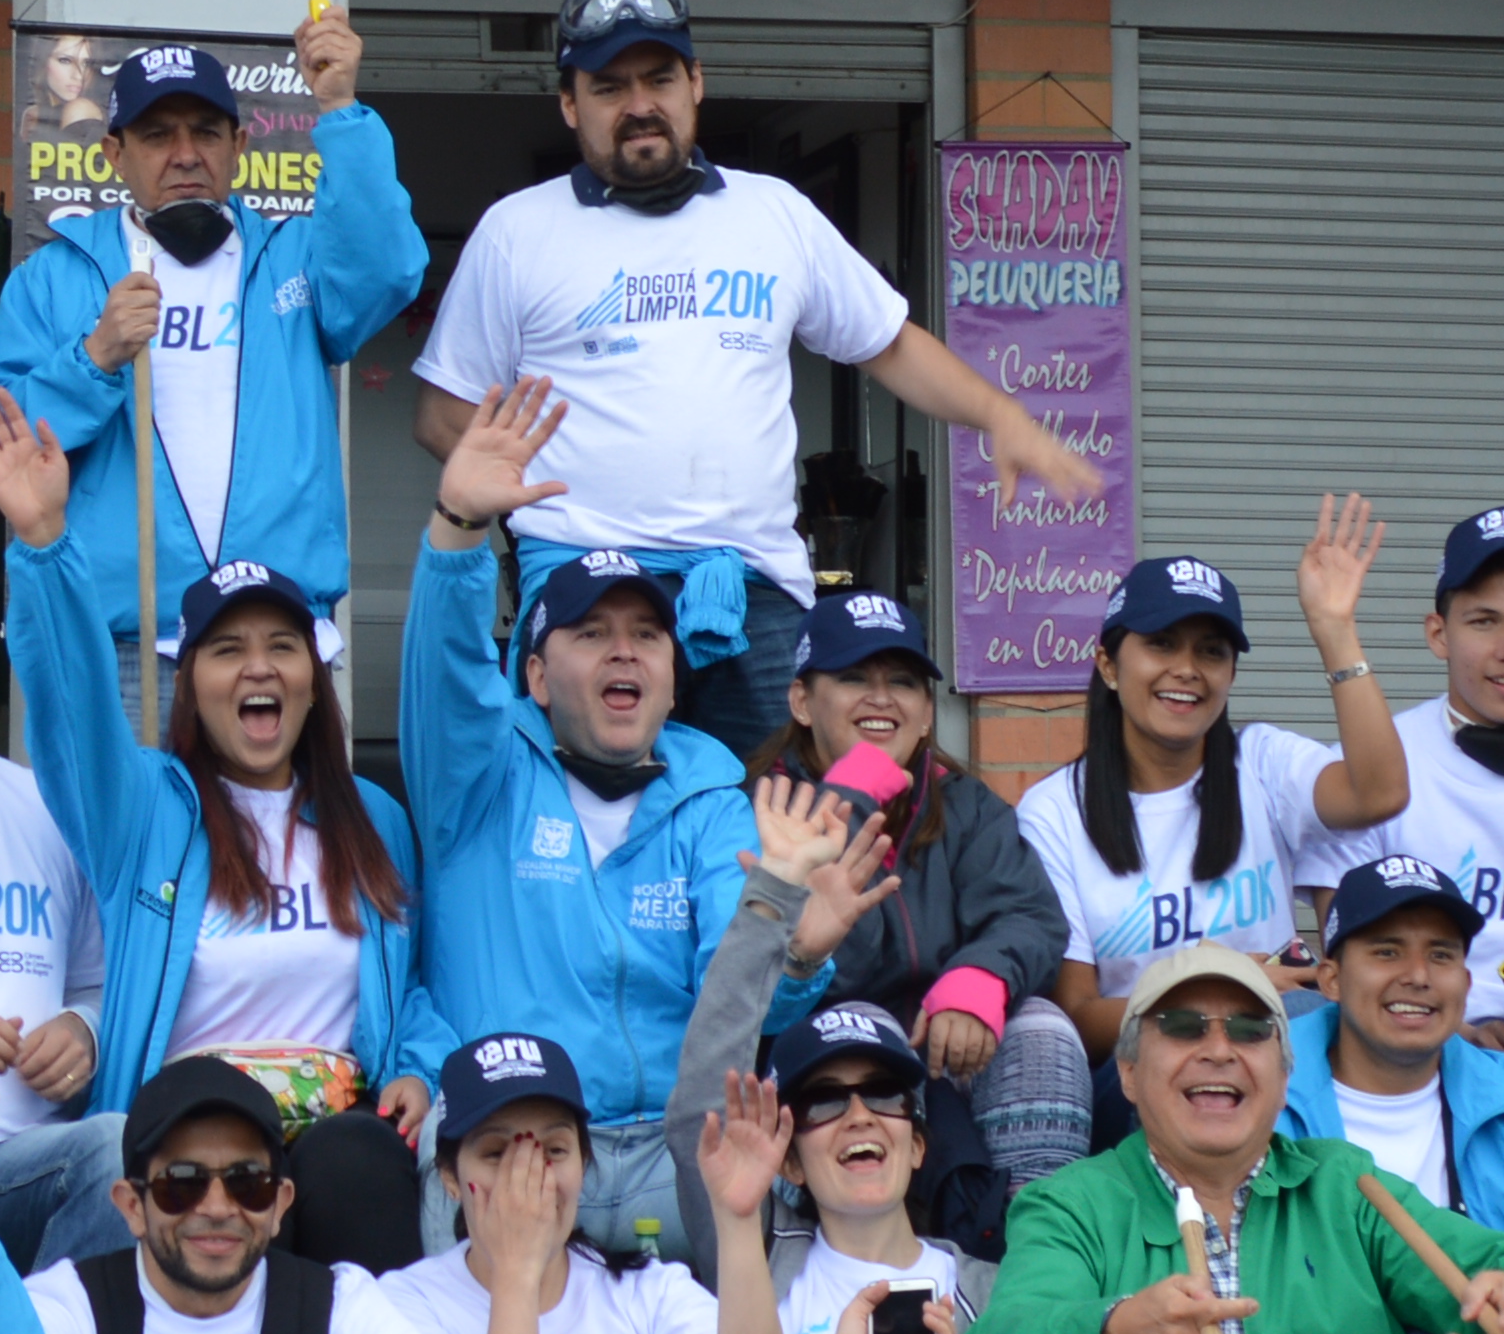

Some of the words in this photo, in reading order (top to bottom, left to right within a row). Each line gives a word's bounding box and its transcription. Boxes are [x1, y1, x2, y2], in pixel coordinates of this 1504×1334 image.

[33, 186, 92, 202] POR
[947, 151, 1121, 261] SHADAY
[625, 268, 696, 297] BOGOTÁ
[701, 269, 780, 324] 20K
[949, 259, 1121, 311] PELUQUERIA
[625, 294, 698, 324] LIMPIA
[986, 636, 1023, 664] en
[633, 876, 687, 898] BOGOT
[631, 897, 690, 918] MEJO
[664, 918, 690, 931] TOD
